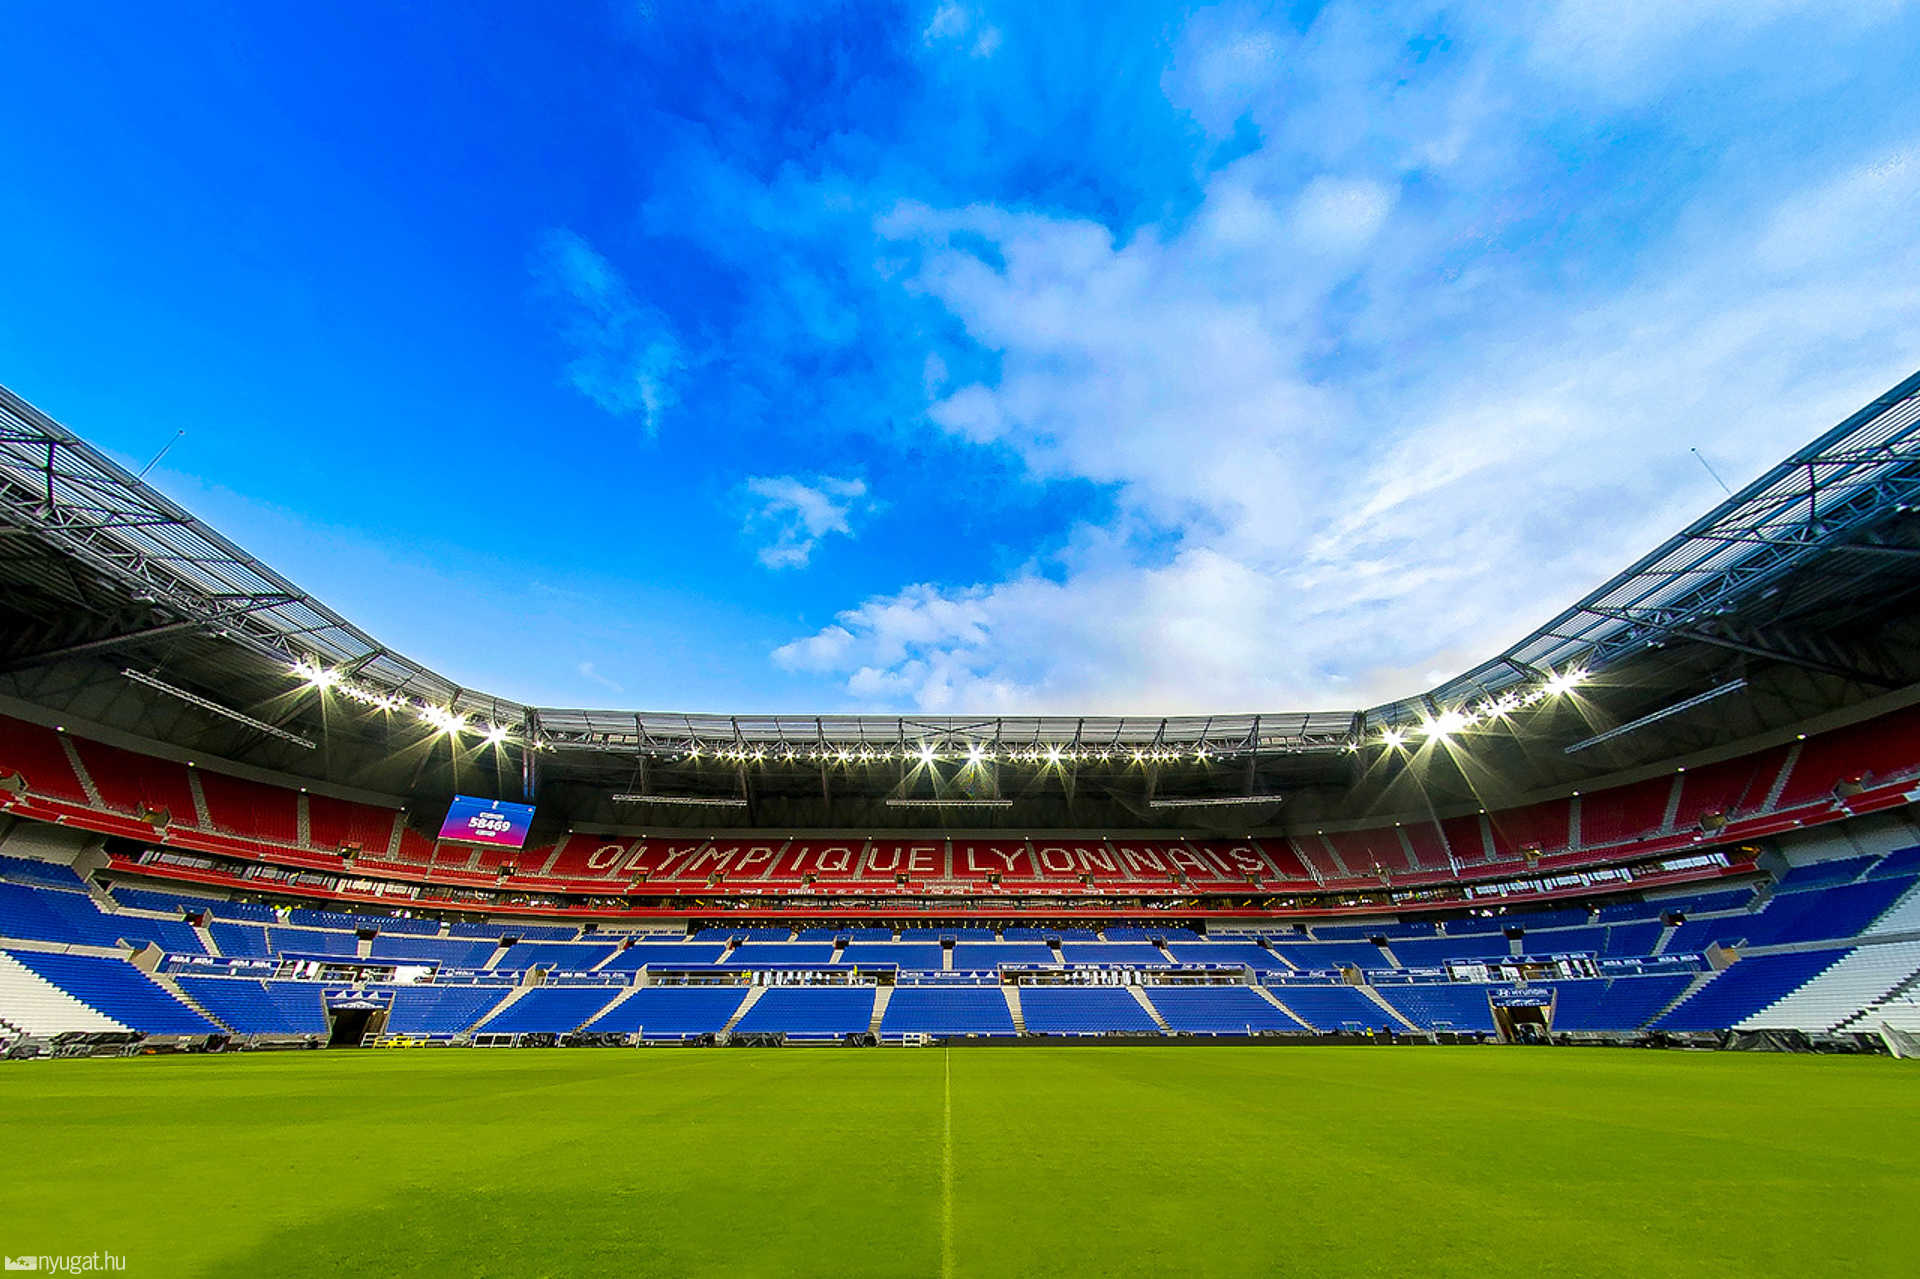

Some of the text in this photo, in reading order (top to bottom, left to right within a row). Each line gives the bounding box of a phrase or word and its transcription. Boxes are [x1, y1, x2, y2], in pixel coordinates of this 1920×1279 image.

[468, 816, 511, 832] 58469
[587, 844, 1266, 872] OLYMPIQUE LYONNAIS
